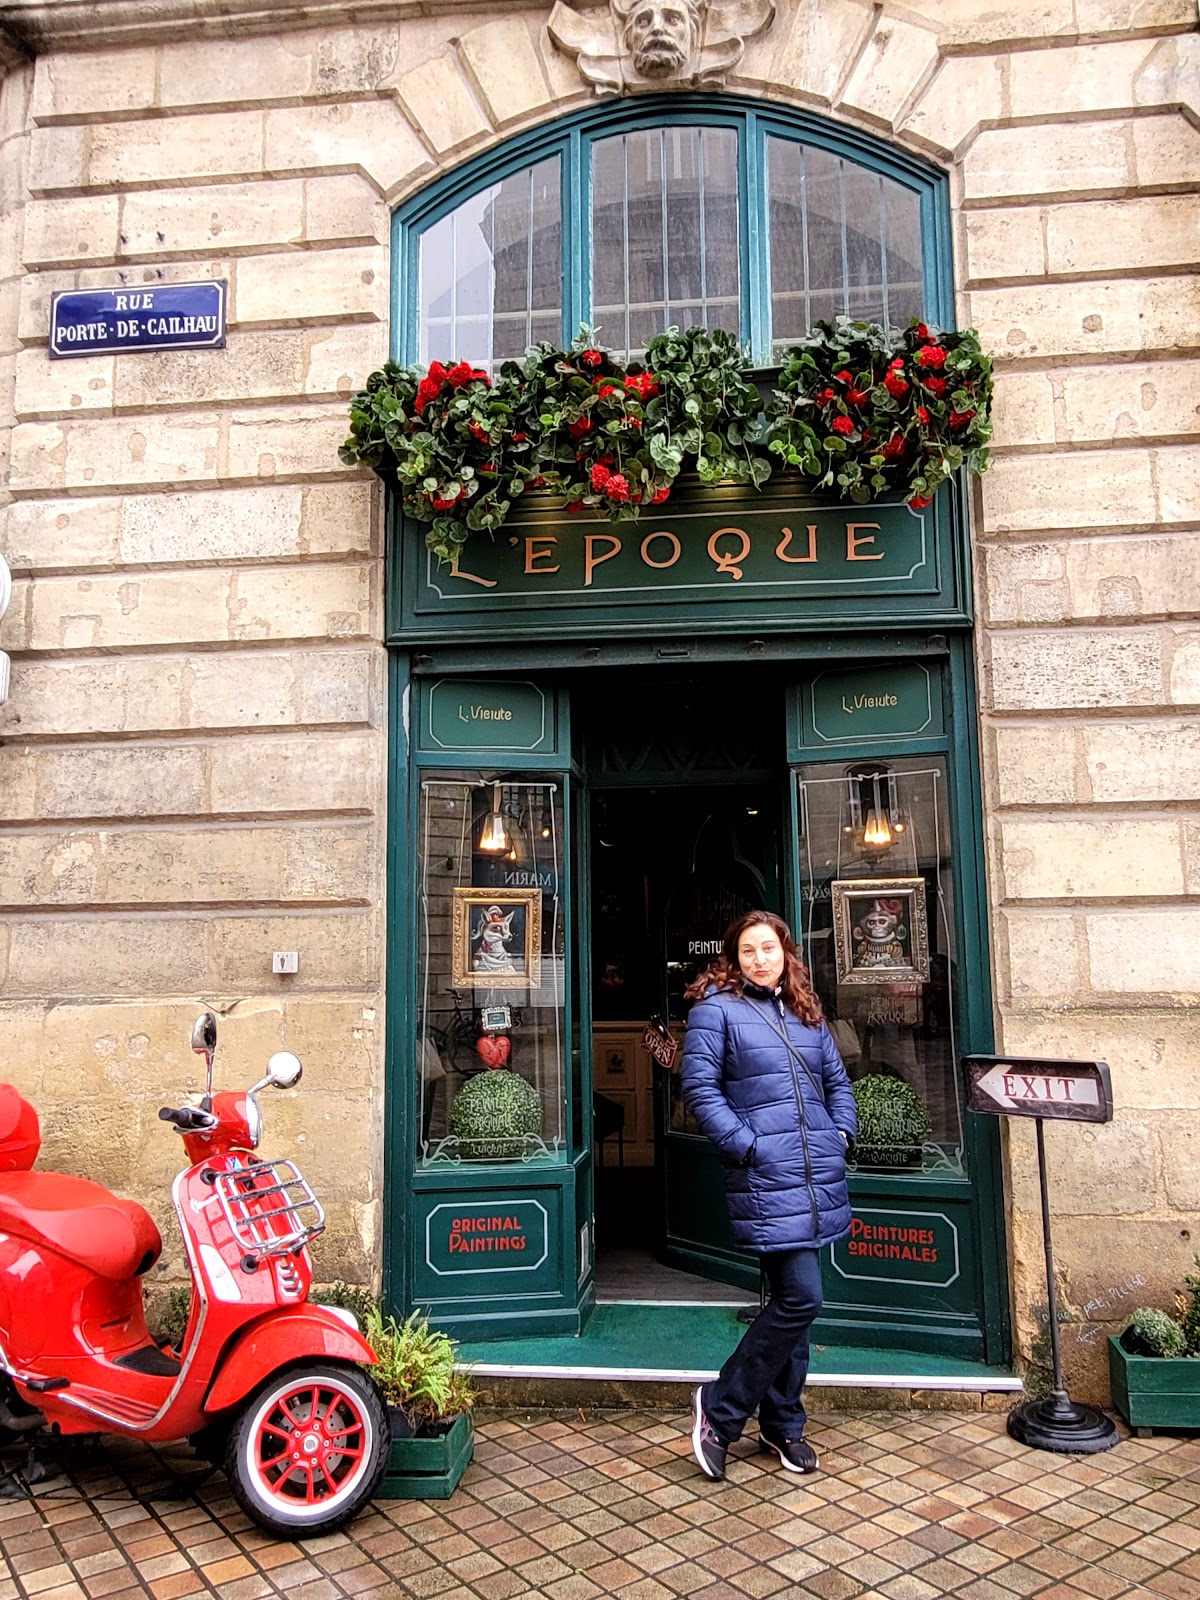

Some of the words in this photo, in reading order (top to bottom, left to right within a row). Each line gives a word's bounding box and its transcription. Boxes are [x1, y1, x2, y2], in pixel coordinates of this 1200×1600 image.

[115, 293, 154, 311] RUE
[645, 1032, 671, 1065] OPEN
[1002, 1075, 1076, 1101] EXIT
[452, 1216, 522, 1233] ORIGINAL
[850, 1218, 934, 1245] PEINTURES
[449, 1233, 526, 1254] PAINTINGS
[847, 1240, 938, 1263] ORIGINALES
